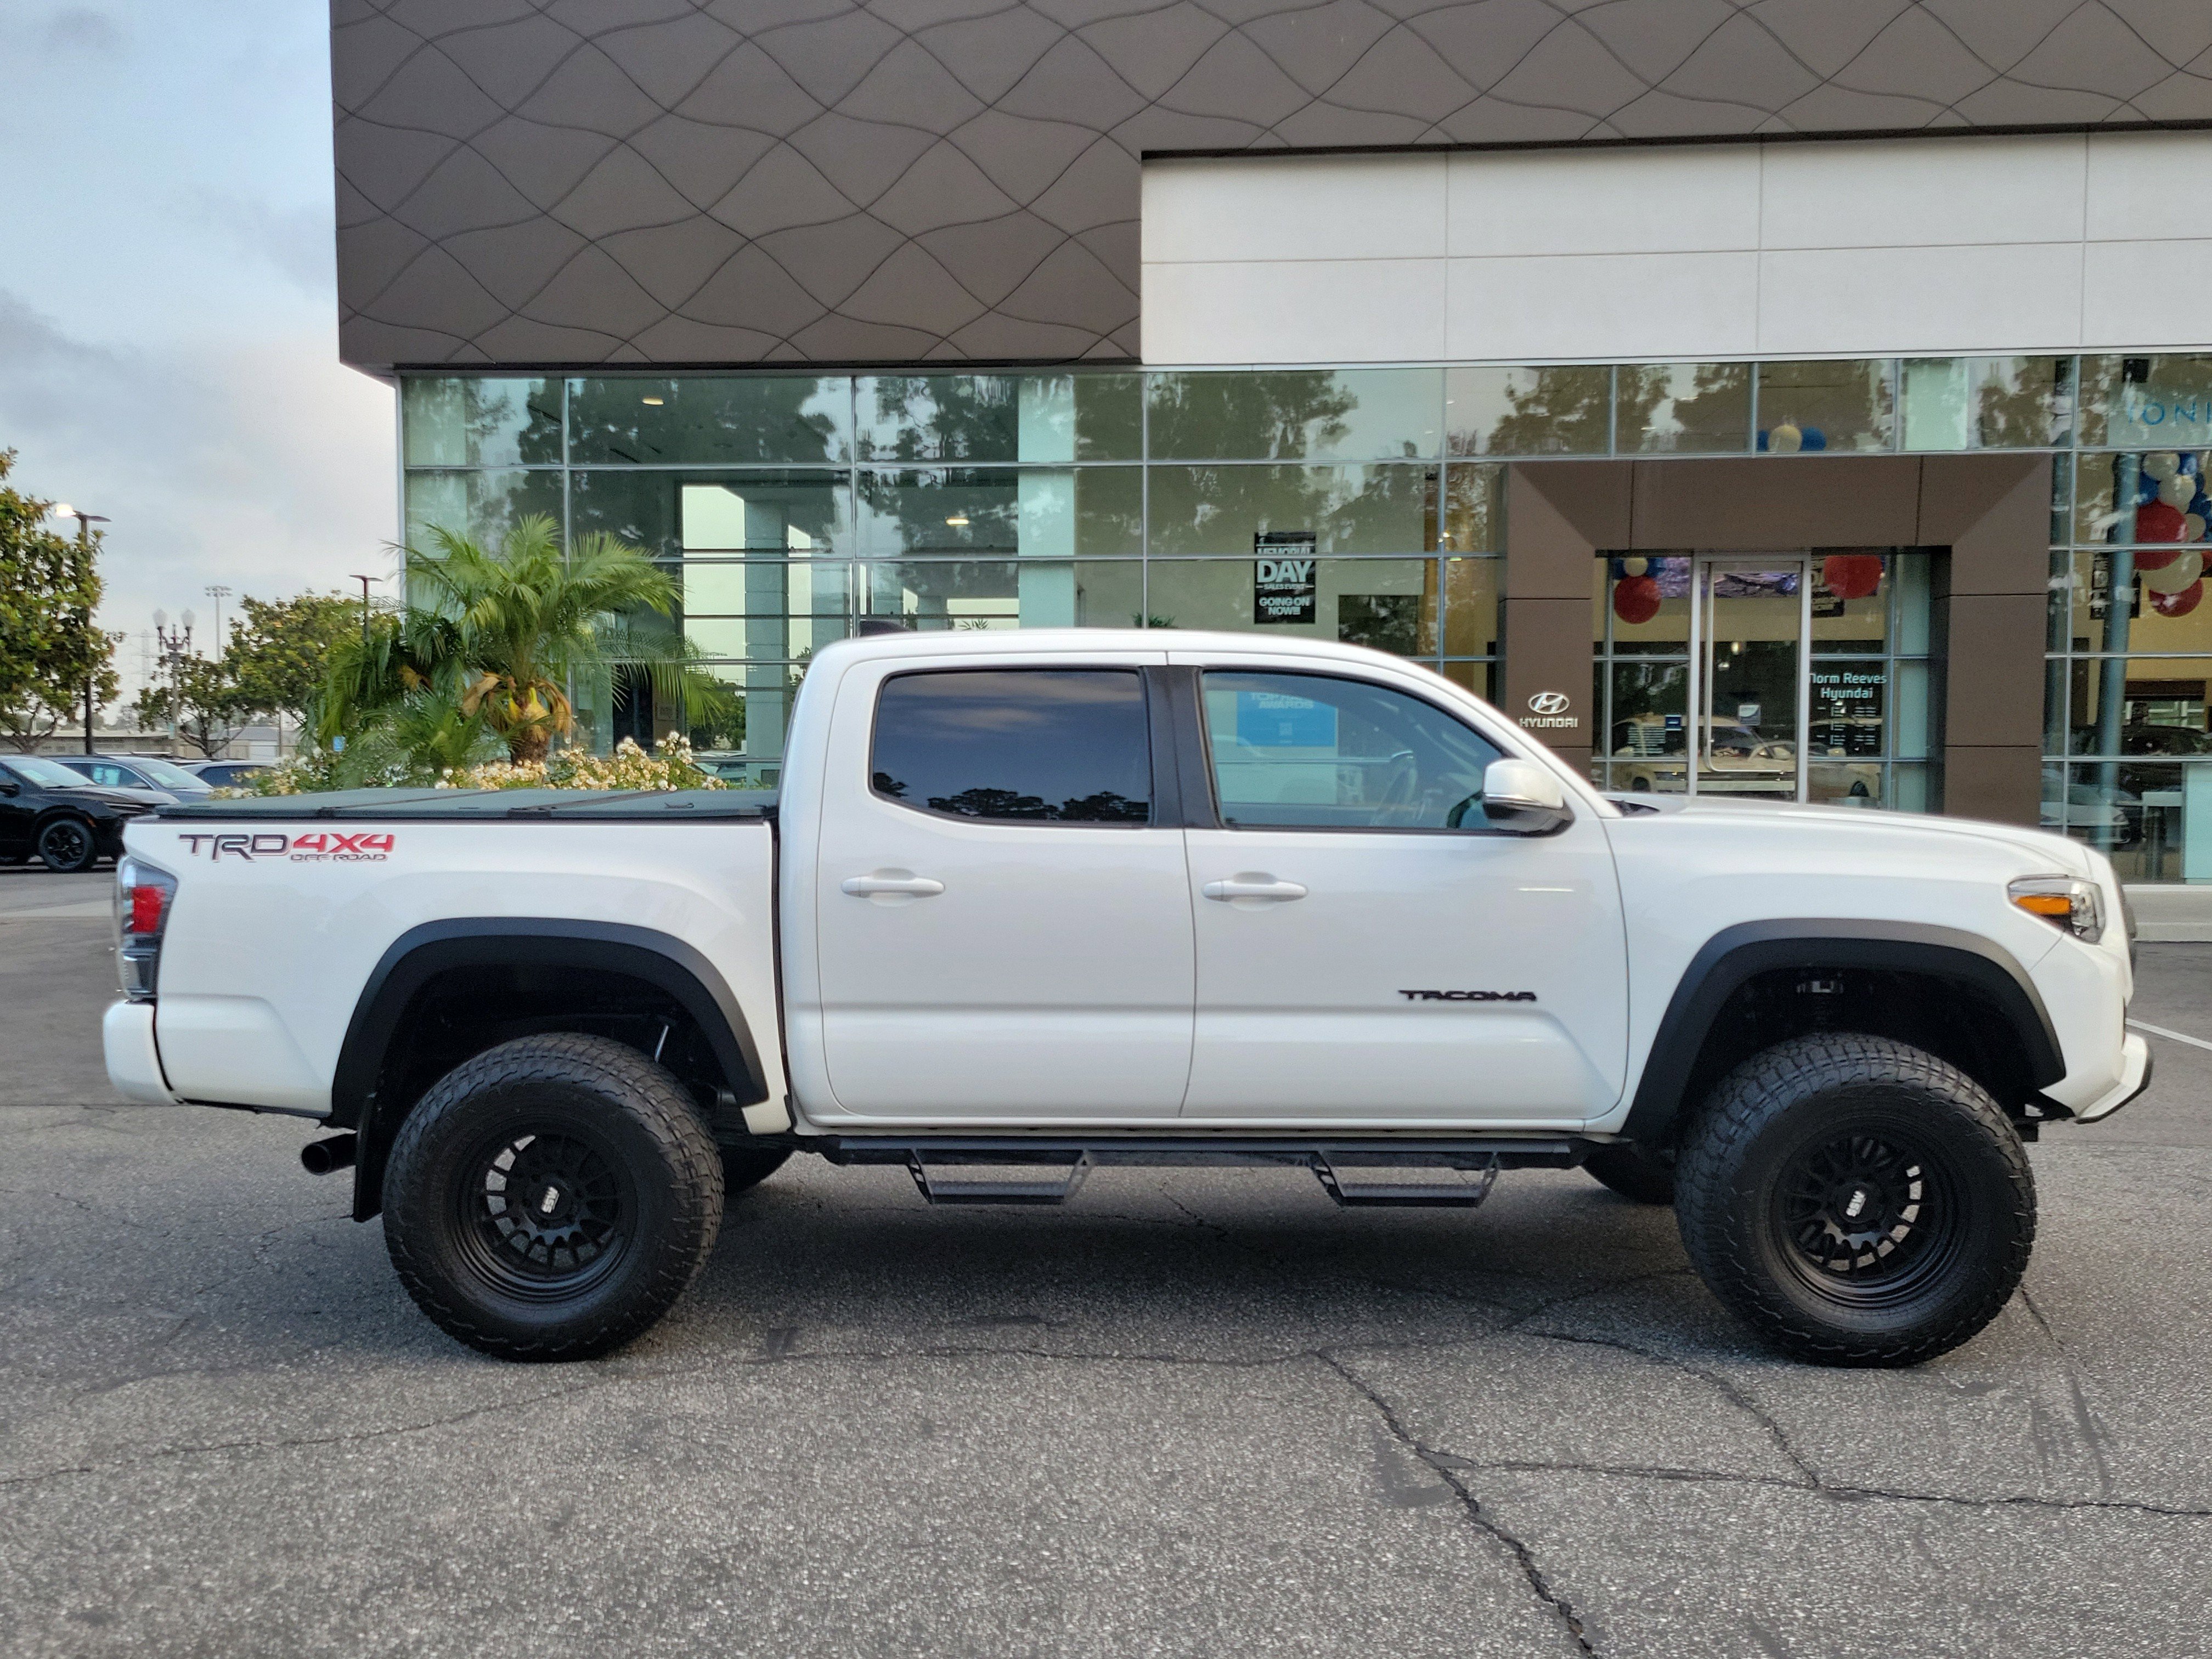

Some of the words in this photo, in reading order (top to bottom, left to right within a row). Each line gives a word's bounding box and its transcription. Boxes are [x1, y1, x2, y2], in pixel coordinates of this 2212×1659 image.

[1257, 560, 1313, 583] DAY
[1259, 597, 1293, 607] GOING
[1294, 597, 1310, 607] ON
[1843, 672, 1887, 684] Reeves
[1820, 687, 1873, 701] Hyundai
[1519, 718, 1578, 728] HYUNDAI
[179, 834, 290, 862] TRD
[1398, 990, 1538, 1002] TACOMA
